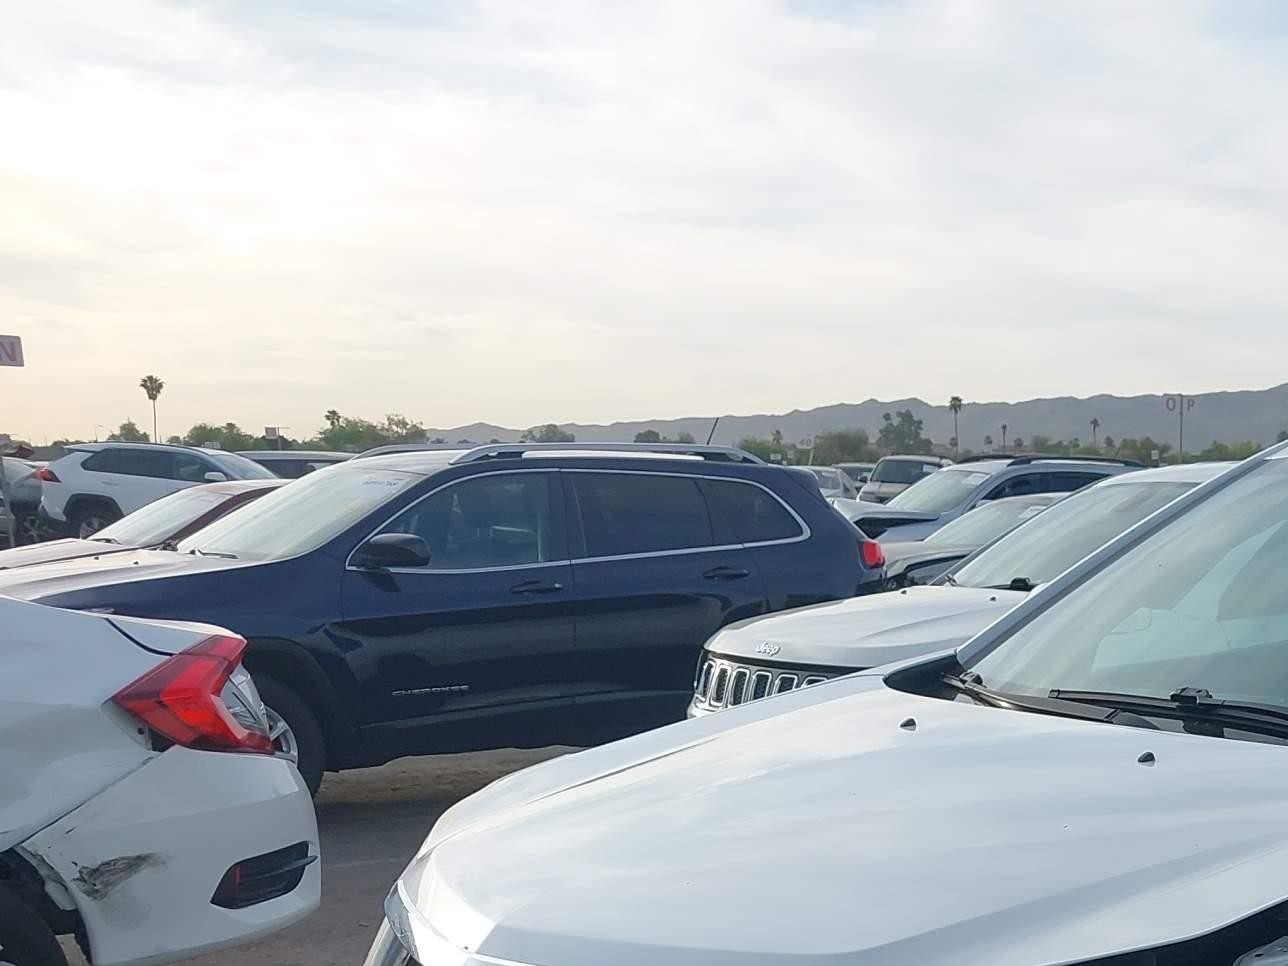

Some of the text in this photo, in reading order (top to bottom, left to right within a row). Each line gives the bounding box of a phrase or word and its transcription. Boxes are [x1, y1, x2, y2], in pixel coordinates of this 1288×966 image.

[1187, 398, 1196, 412] P
[755, 641, 781, 657] Jeep
[391, 685, 470, 697] CHEROKEE
